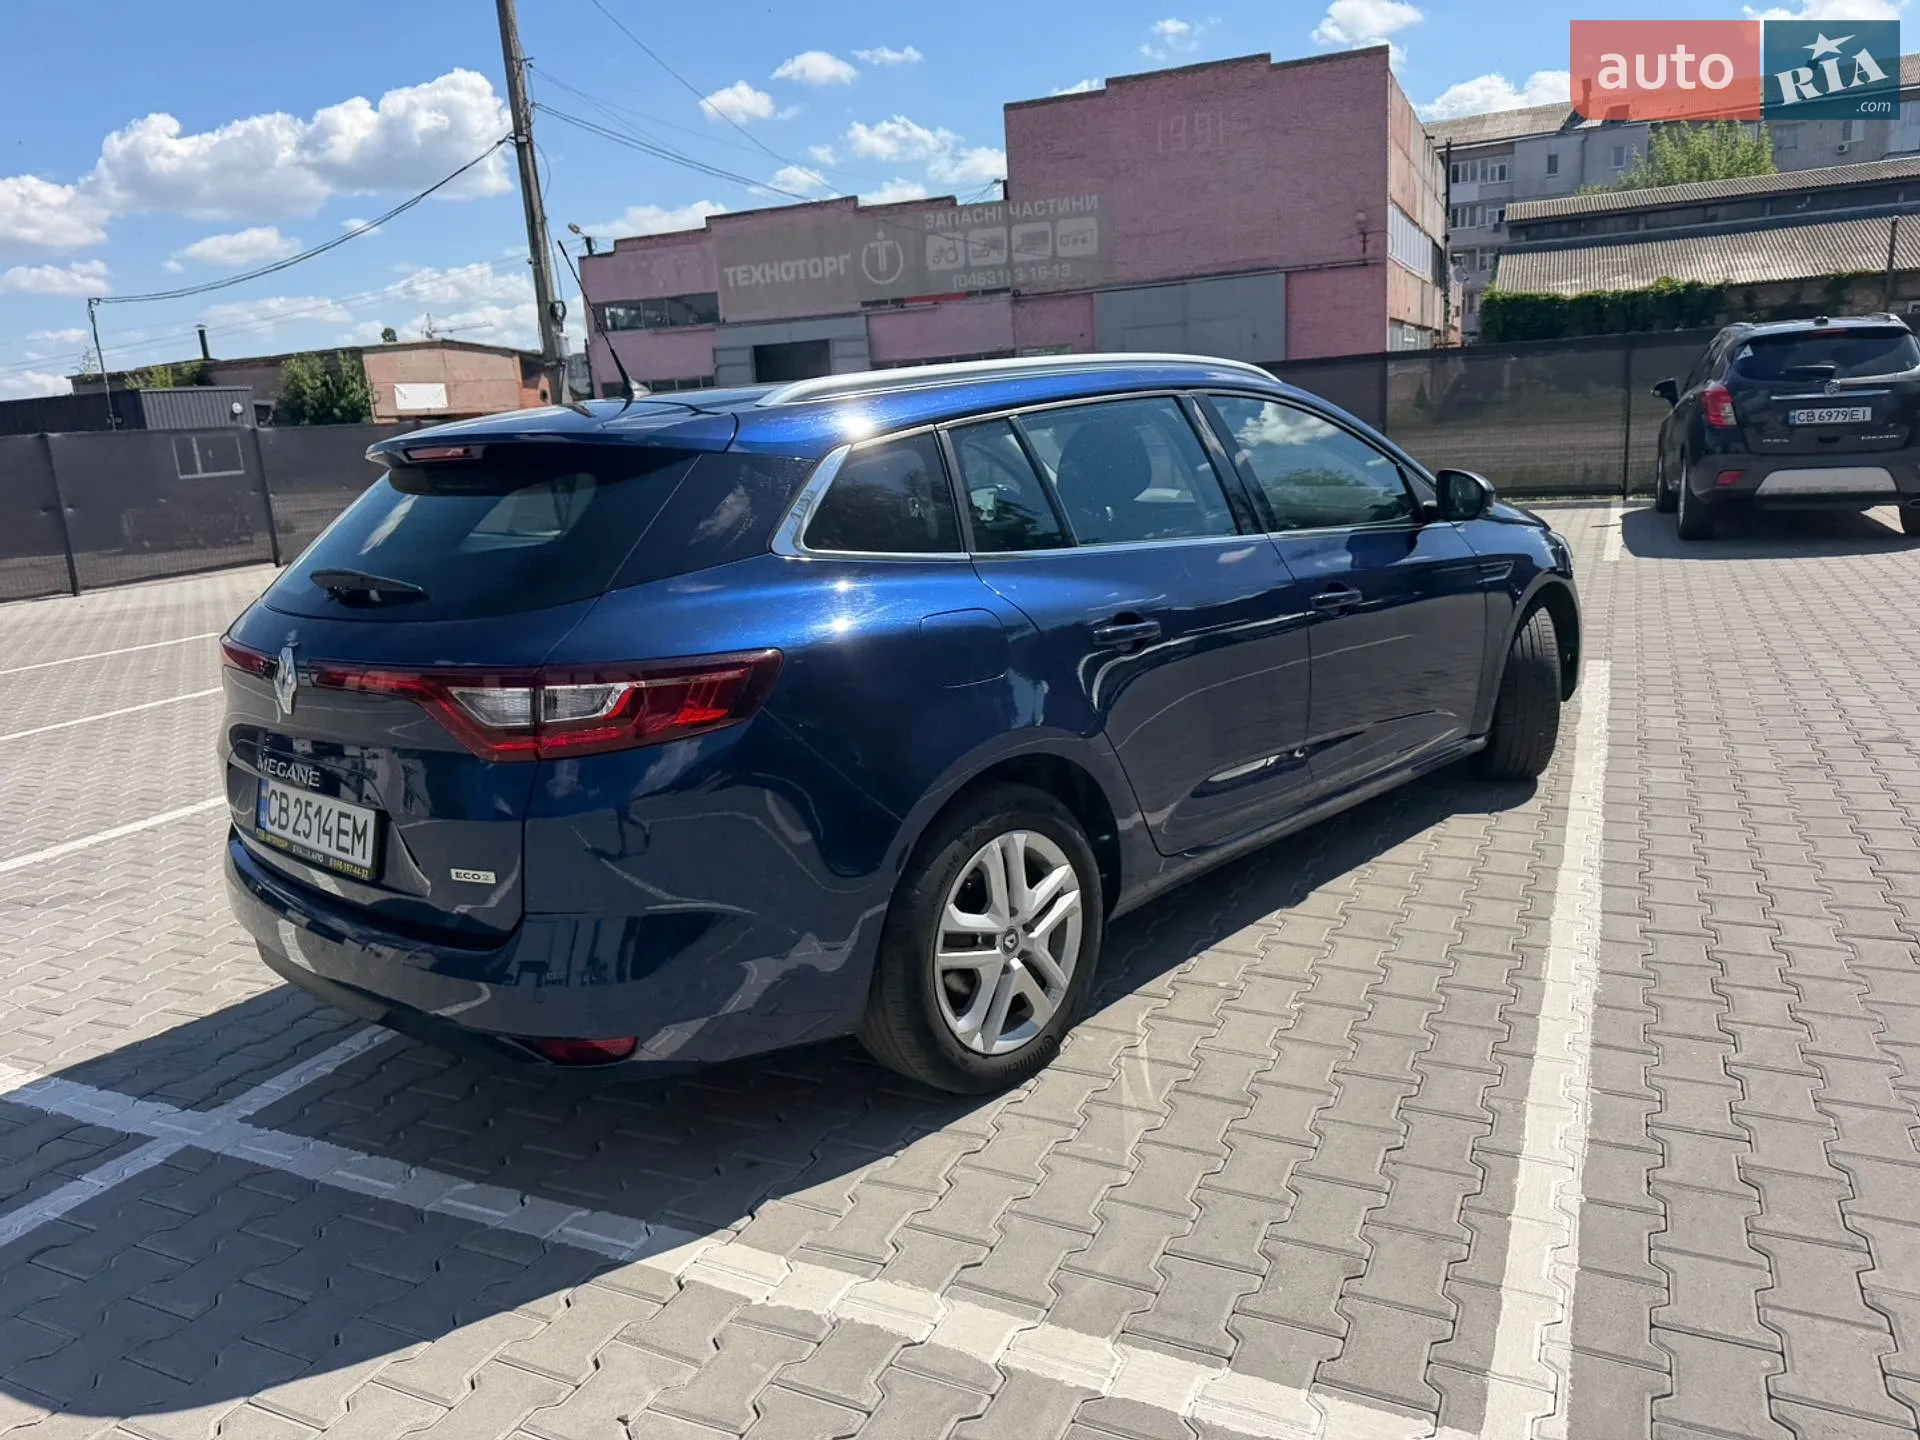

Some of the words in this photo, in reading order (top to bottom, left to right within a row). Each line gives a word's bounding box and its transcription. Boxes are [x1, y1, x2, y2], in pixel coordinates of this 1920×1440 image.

[924, 206, 1001, 229] ЗАПАСНІ
[1009, 194, 1098, 218] ЧАСТИНИ
[724, 253, 852, 287] ТЕХНОТОРГ
[258, 754, 320, 787] MEGANE
